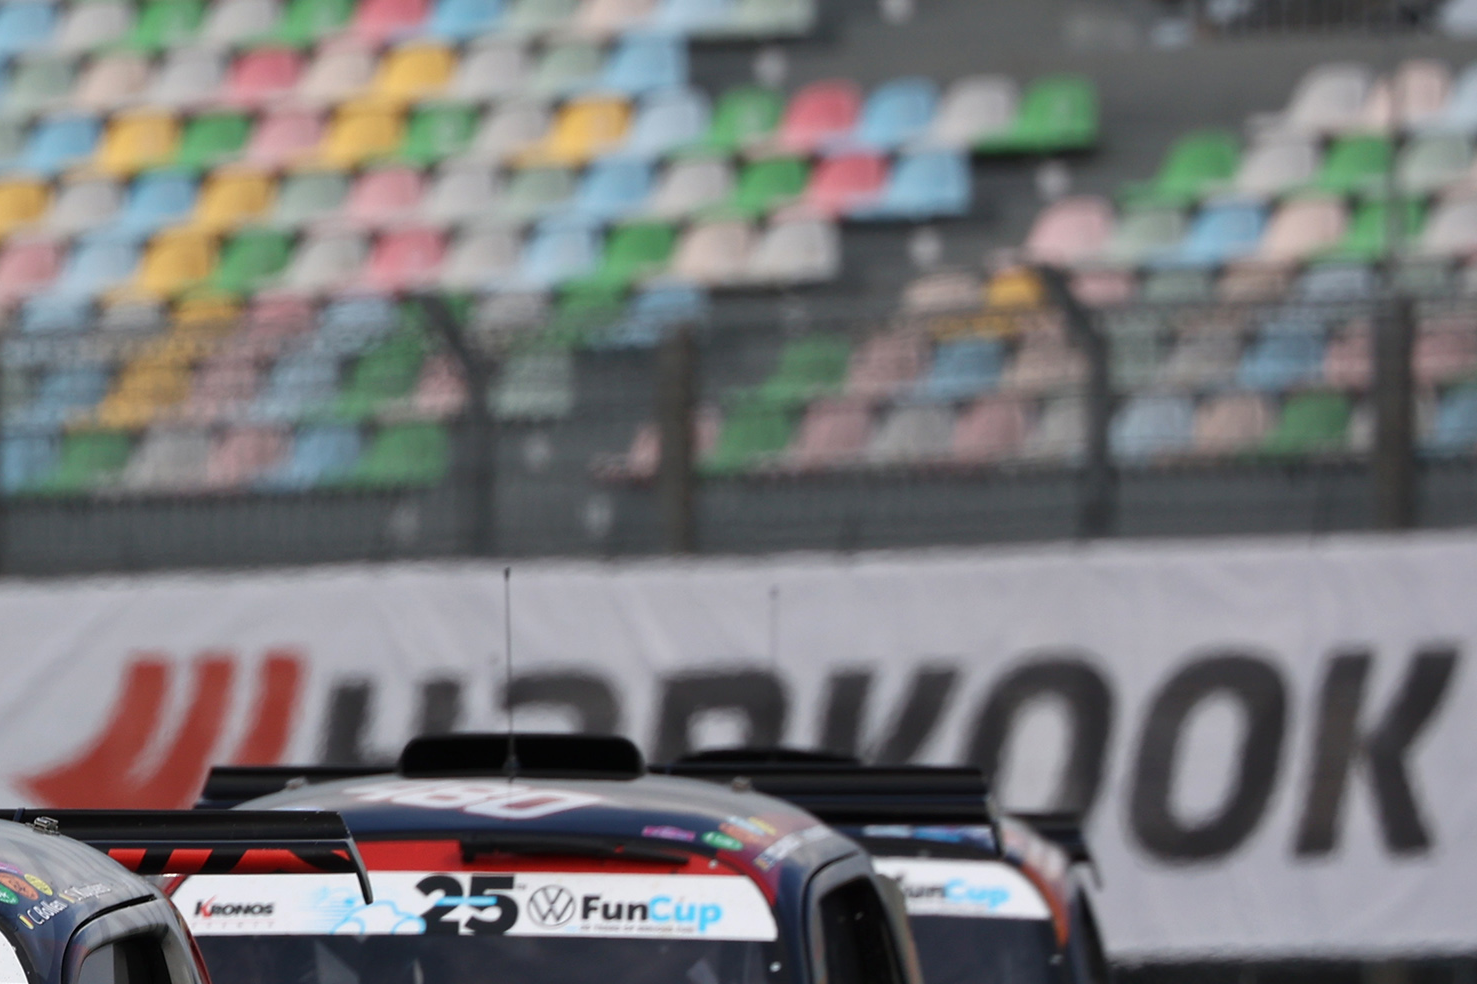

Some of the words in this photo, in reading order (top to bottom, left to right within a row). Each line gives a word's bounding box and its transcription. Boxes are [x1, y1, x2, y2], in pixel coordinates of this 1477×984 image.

[194, 894, 275, 919] KRONOS
[415, 874, 520, 936] 25
[581, 894, 723, 932] FunCup
[898, 878, 1011, 912] unCup
